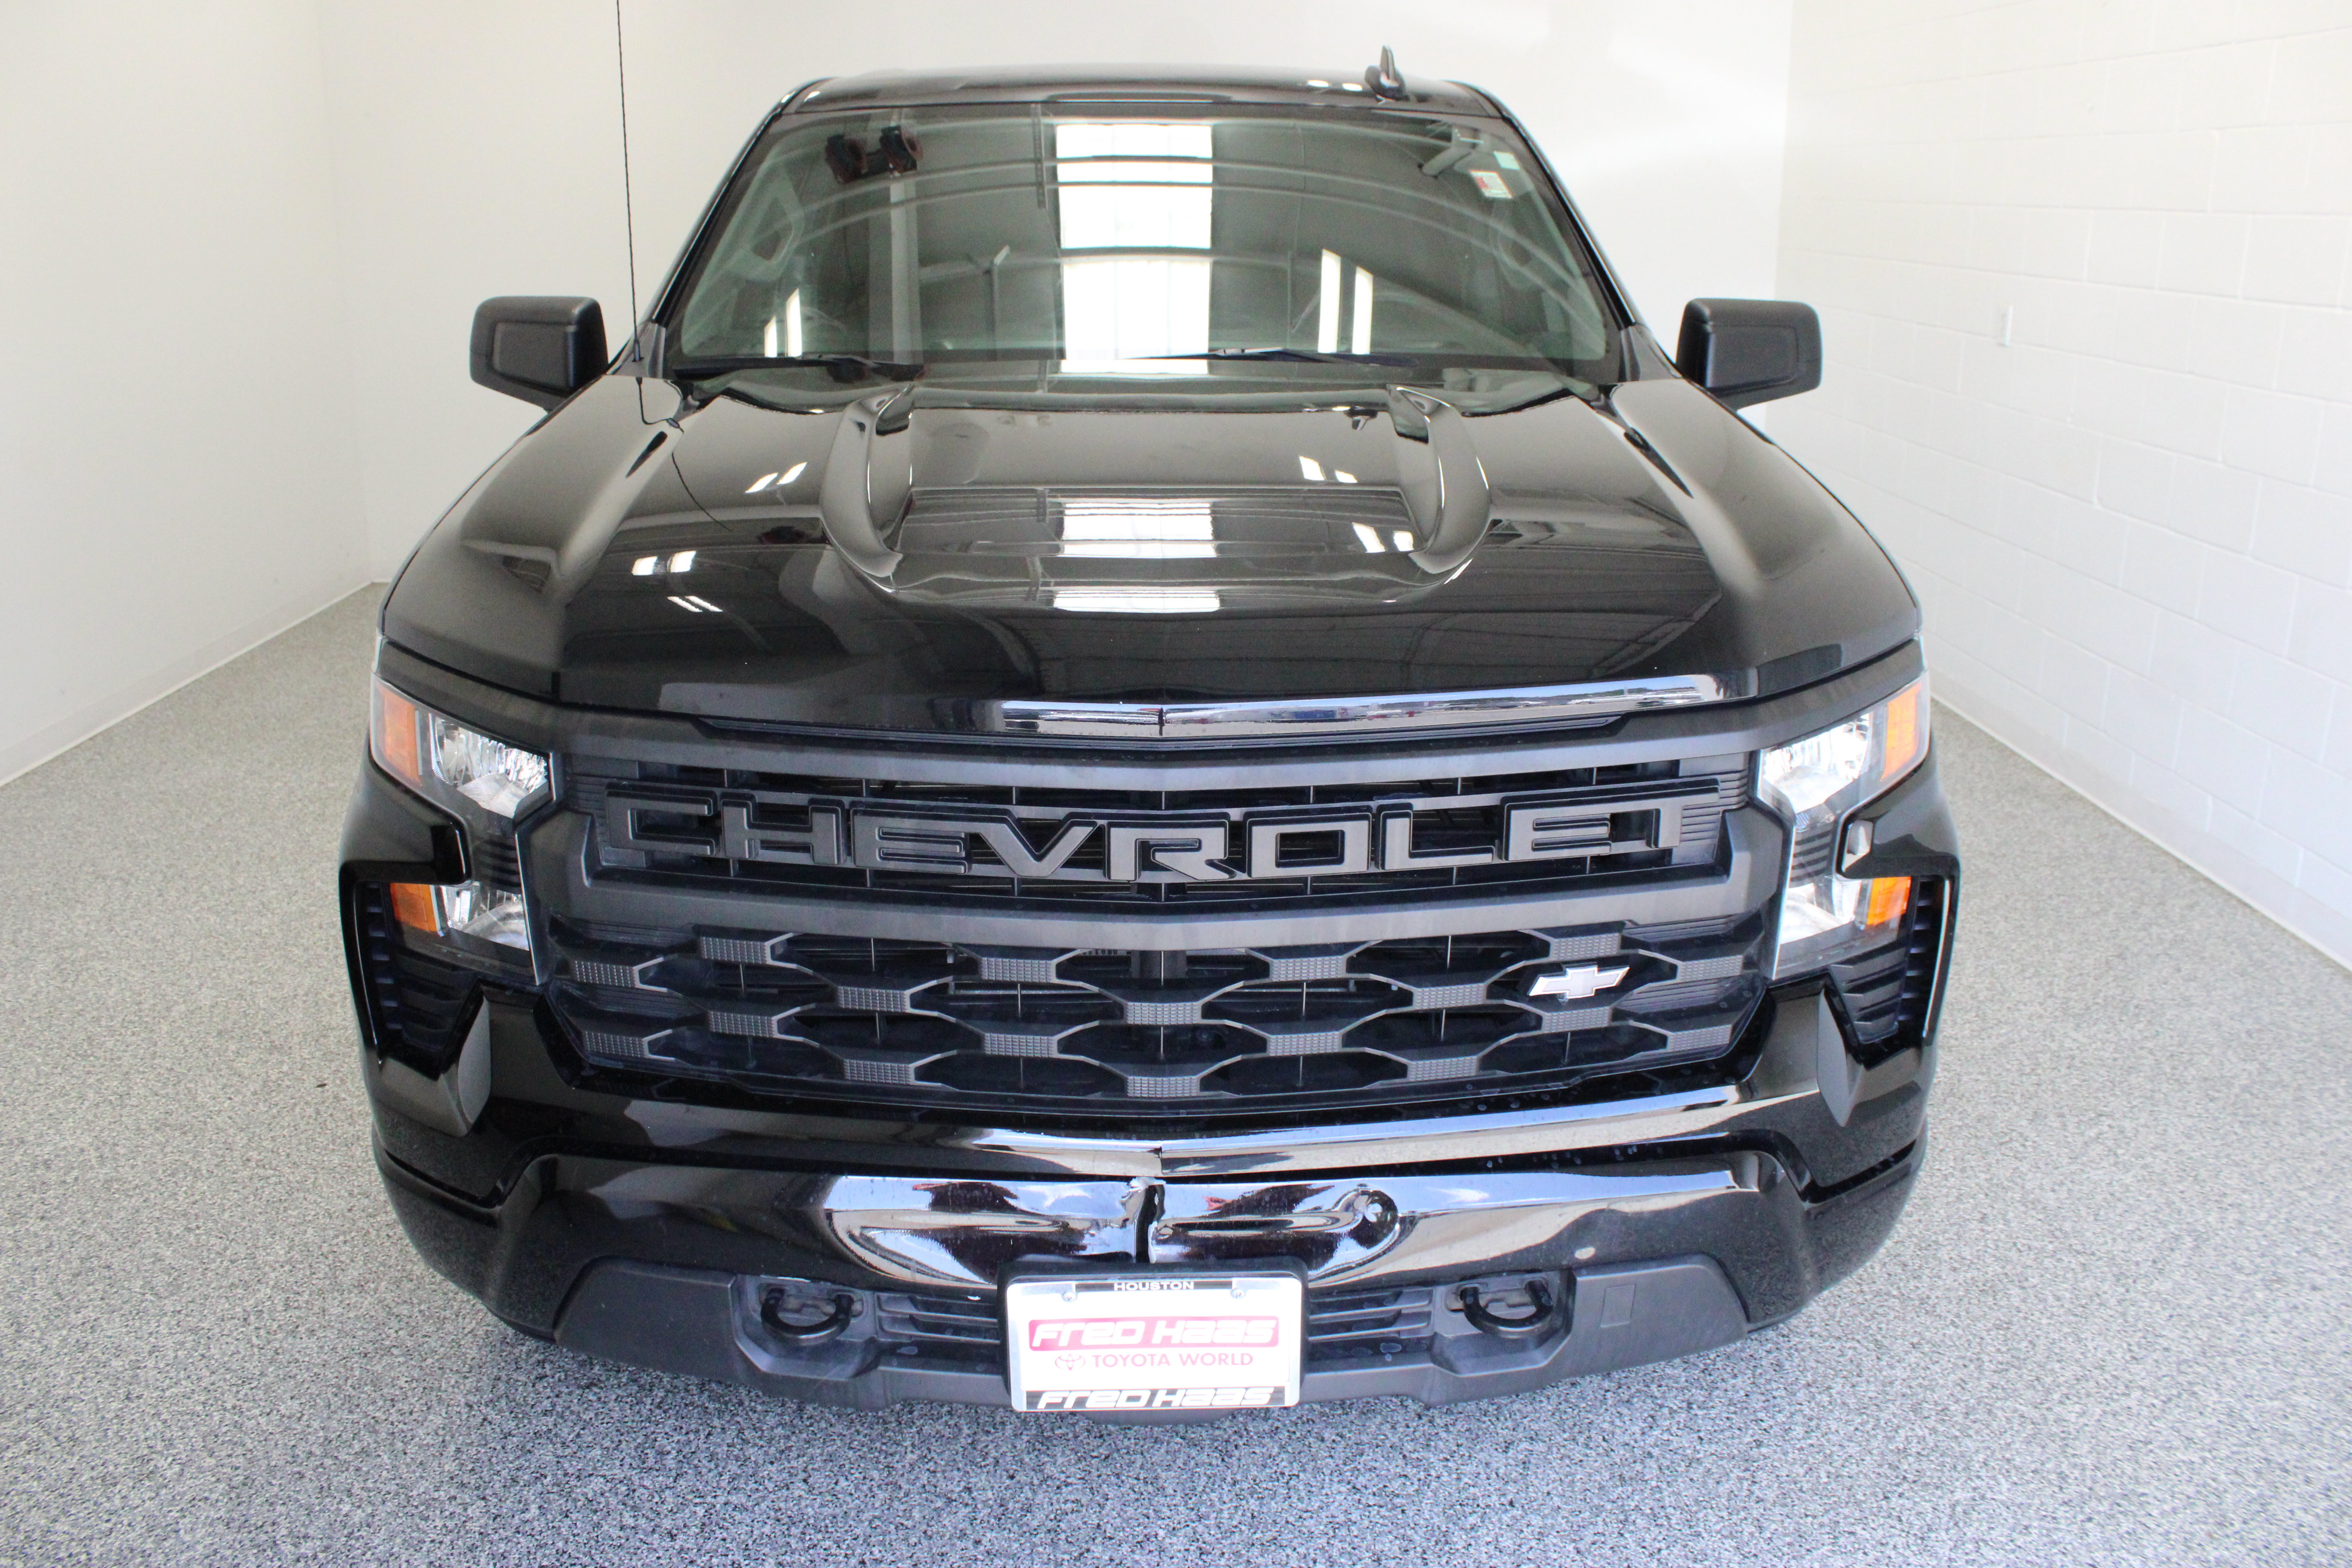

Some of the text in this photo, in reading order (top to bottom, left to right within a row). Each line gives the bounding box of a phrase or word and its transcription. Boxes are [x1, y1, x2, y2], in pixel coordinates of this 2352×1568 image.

[606, 786, 1720, 881] CHEVROLET
[1114, 1281, 1194, 1291] HOUSTON
[1092, 1352, 1254, 1368] TOYOTA WORLD
